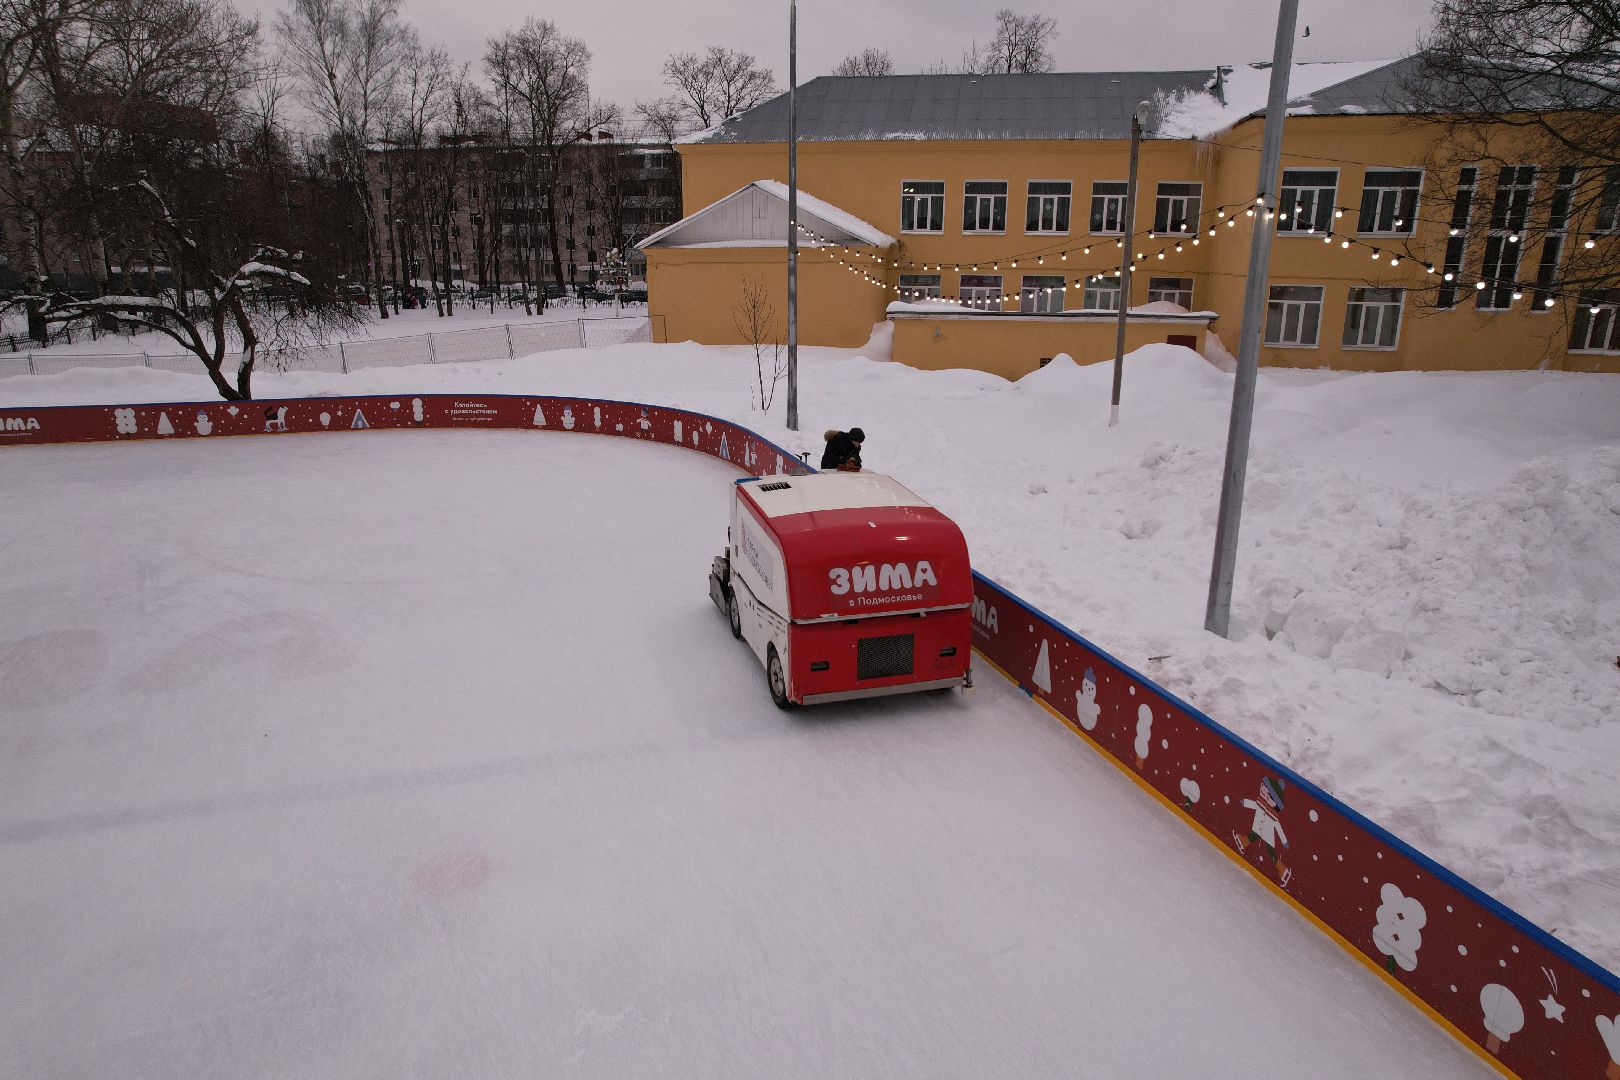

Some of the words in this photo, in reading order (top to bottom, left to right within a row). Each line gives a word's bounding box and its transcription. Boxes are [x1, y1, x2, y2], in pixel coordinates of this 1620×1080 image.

[828, 560, 938, 595] ЗИМА
[849, 599, 855, 607] в
[857, 593, 923, 606] Подмосковье
